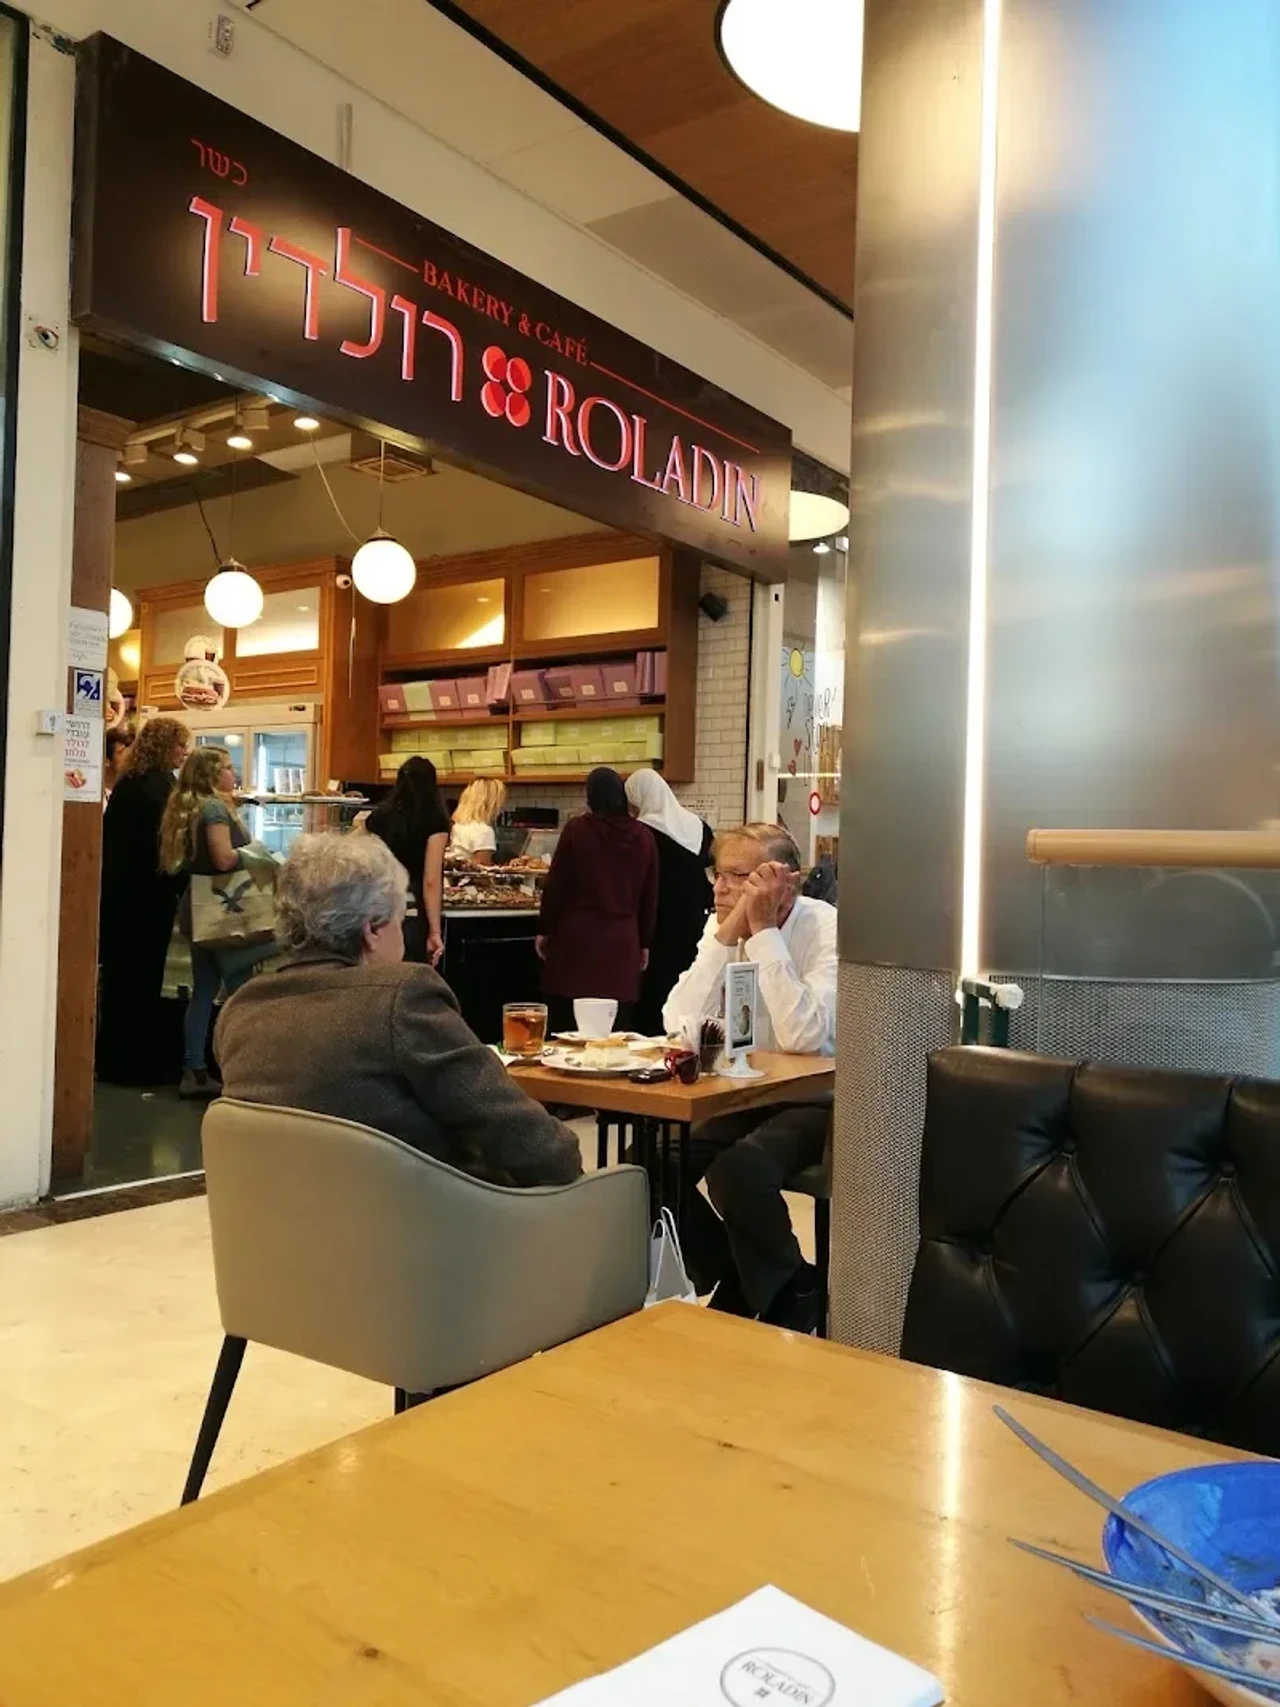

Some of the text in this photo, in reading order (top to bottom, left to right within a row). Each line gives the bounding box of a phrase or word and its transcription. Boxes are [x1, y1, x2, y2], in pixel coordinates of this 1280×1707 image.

[190, 138, 248, 186] כשר
[188, 195, 465, 402] רולדין
[423, 260, 590, 366] BAKERY & CAFÉ
[541, 369, 761, 533] ROLADIN
[65, 720, 91, 730] דרושי
[740, 1659, 814, 1705] ROLADIN
